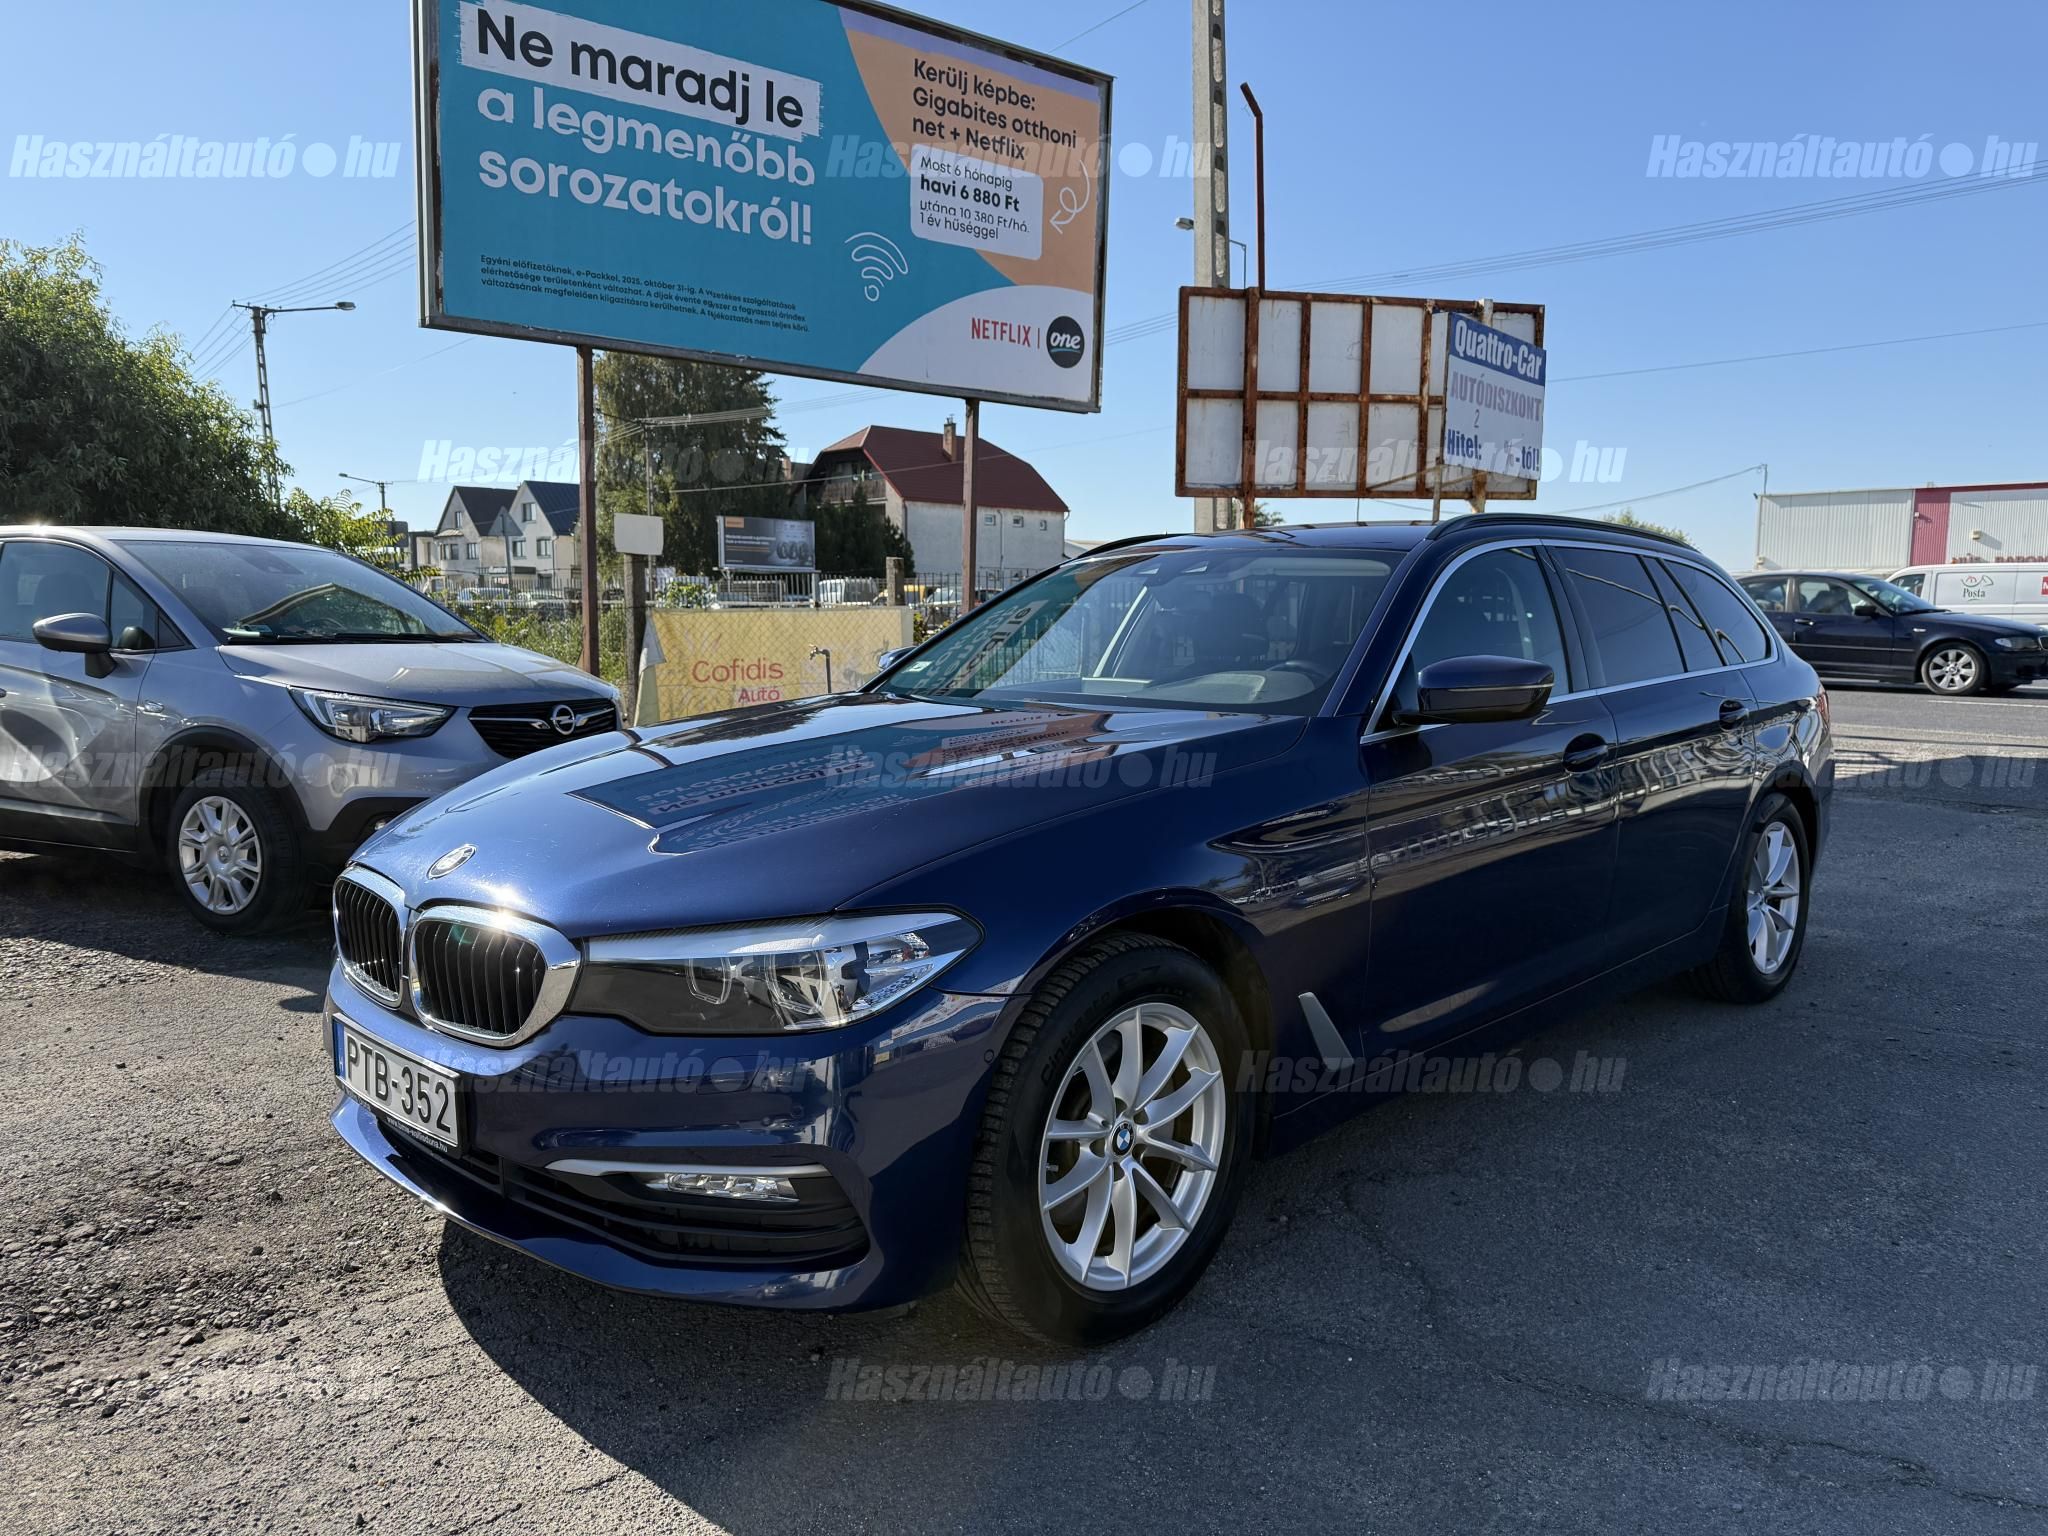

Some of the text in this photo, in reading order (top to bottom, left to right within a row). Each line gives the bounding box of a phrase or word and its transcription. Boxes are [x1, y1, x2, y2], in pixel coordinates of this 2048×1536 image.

[477, 8, 804, 128] Ne maradj le
[914, 58, 1035, 110] Kerülj képbe:
[913, 87, 1077, 148] Gigabites otthoni
[477, 87, 815, 186] a legmenőbb
[913, 117, 1025, 160] net + Netflix
[921, 156, 1012, 191] Most 6 hónapig
[478, 150, 812, 245] sorozatokról!
[920, 174, 1020, 212] havi 6 880 Ft
[920, 200, 956, 216] utána
[960, 208, 971, 219] 10
[974, 211, 994, 225] 380
[927, 214, 942, 228] év
[944, 217, 999, 240] hűséggel
[480, 254, 511, 266] Egyéni
[971, 317, 1031, 348] NETFLIX
[1050, 332, 1081, 349] one
[1454, 320, 1542, 380] Quattro-Car
[1451, 371, 1542, 421] AUTÓDISZKONT
[1446, 429, 1482, 460] Hitel:
[1962, 588, 1986, 598] Posta
[692, 658, 784, 683] Cofidis
[738, 686, 780, 702] Autó
[347, 1035, 451, 1133] PTB-352
